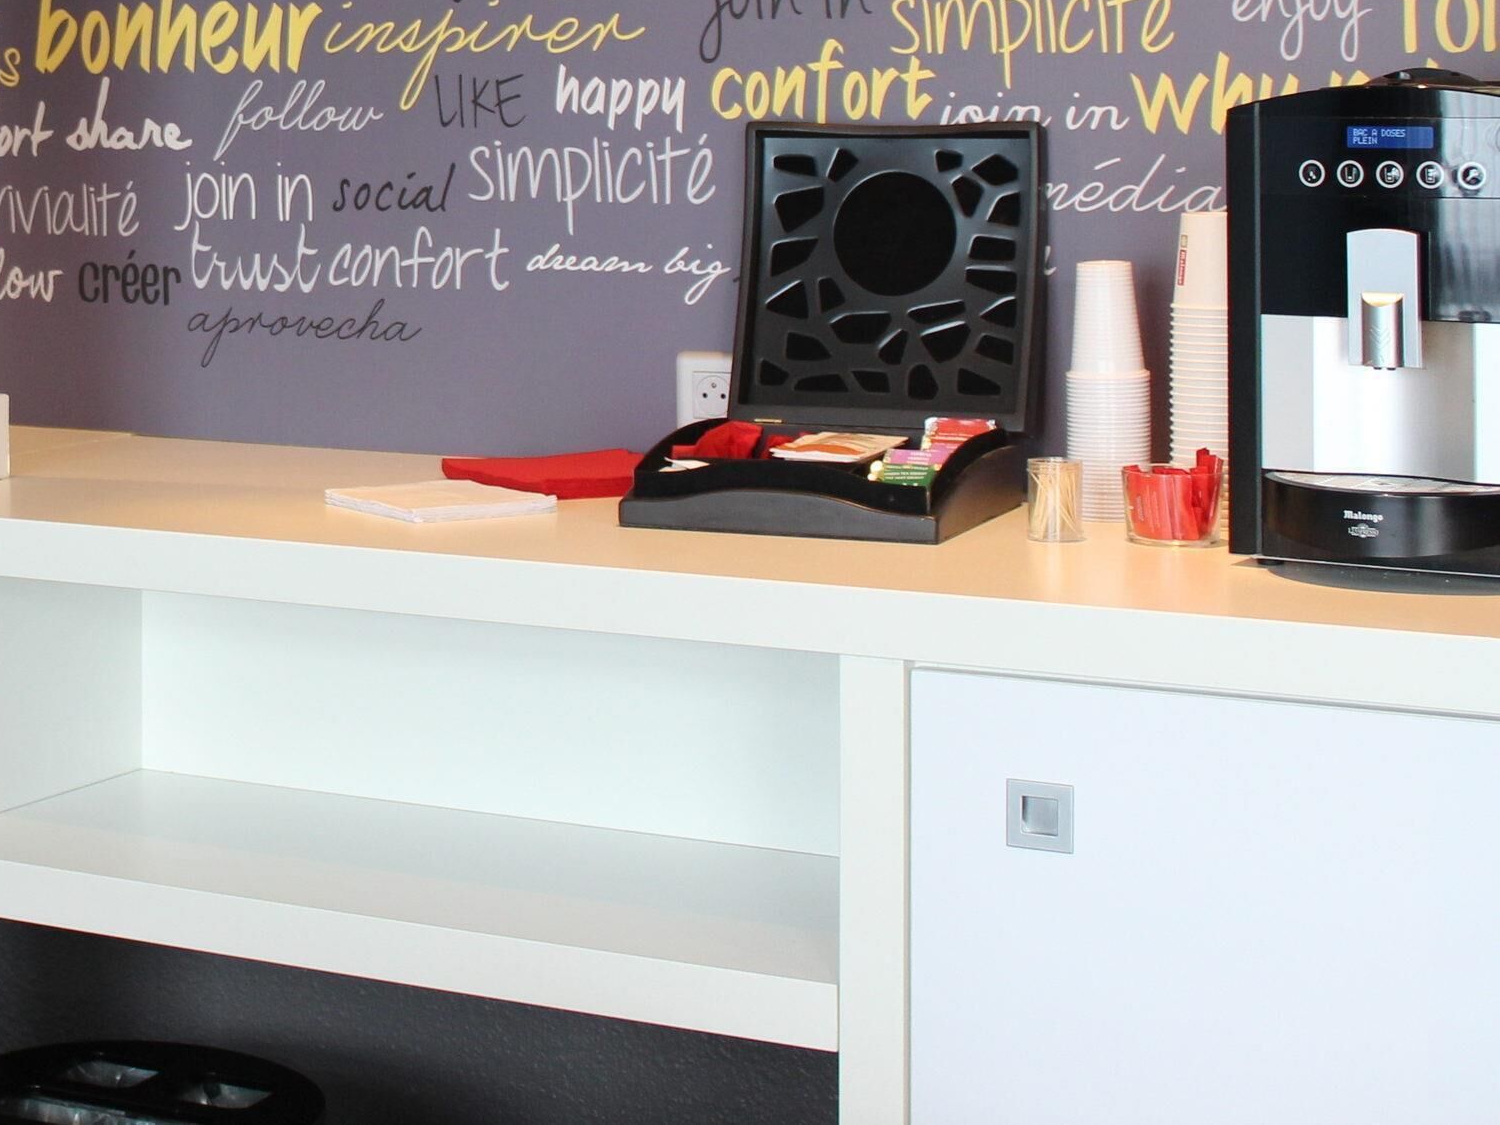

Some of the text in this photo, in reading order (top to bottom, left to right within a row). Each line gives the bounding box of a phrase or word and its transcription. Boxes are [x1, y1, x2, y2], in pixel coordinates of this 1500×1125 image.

[66, 76, 193, 151] share
[435, 73, 528, 129] LIKE
[555, 63, 687, 134] happy
[711, 38, 937, 125] confort
[1065, 91, 1131, 131] in
[214, 79, 384, 162] follow
[1352, 128, 1406, 138] BAC A DOSES
[1352, 136, 1378, 145] PLEIN
[174, 160, 316, 231] join in
[332, 162, 456, 214] social
[468, 132, 717, 236] simplicité
[78, 250, 183, 305] créer
[190, 222, 322, 293] trust
[328, 226, 511, 291] confort
[525, 242, 732, 305] dream big
[186, 297, 423, 369] aprovecha
